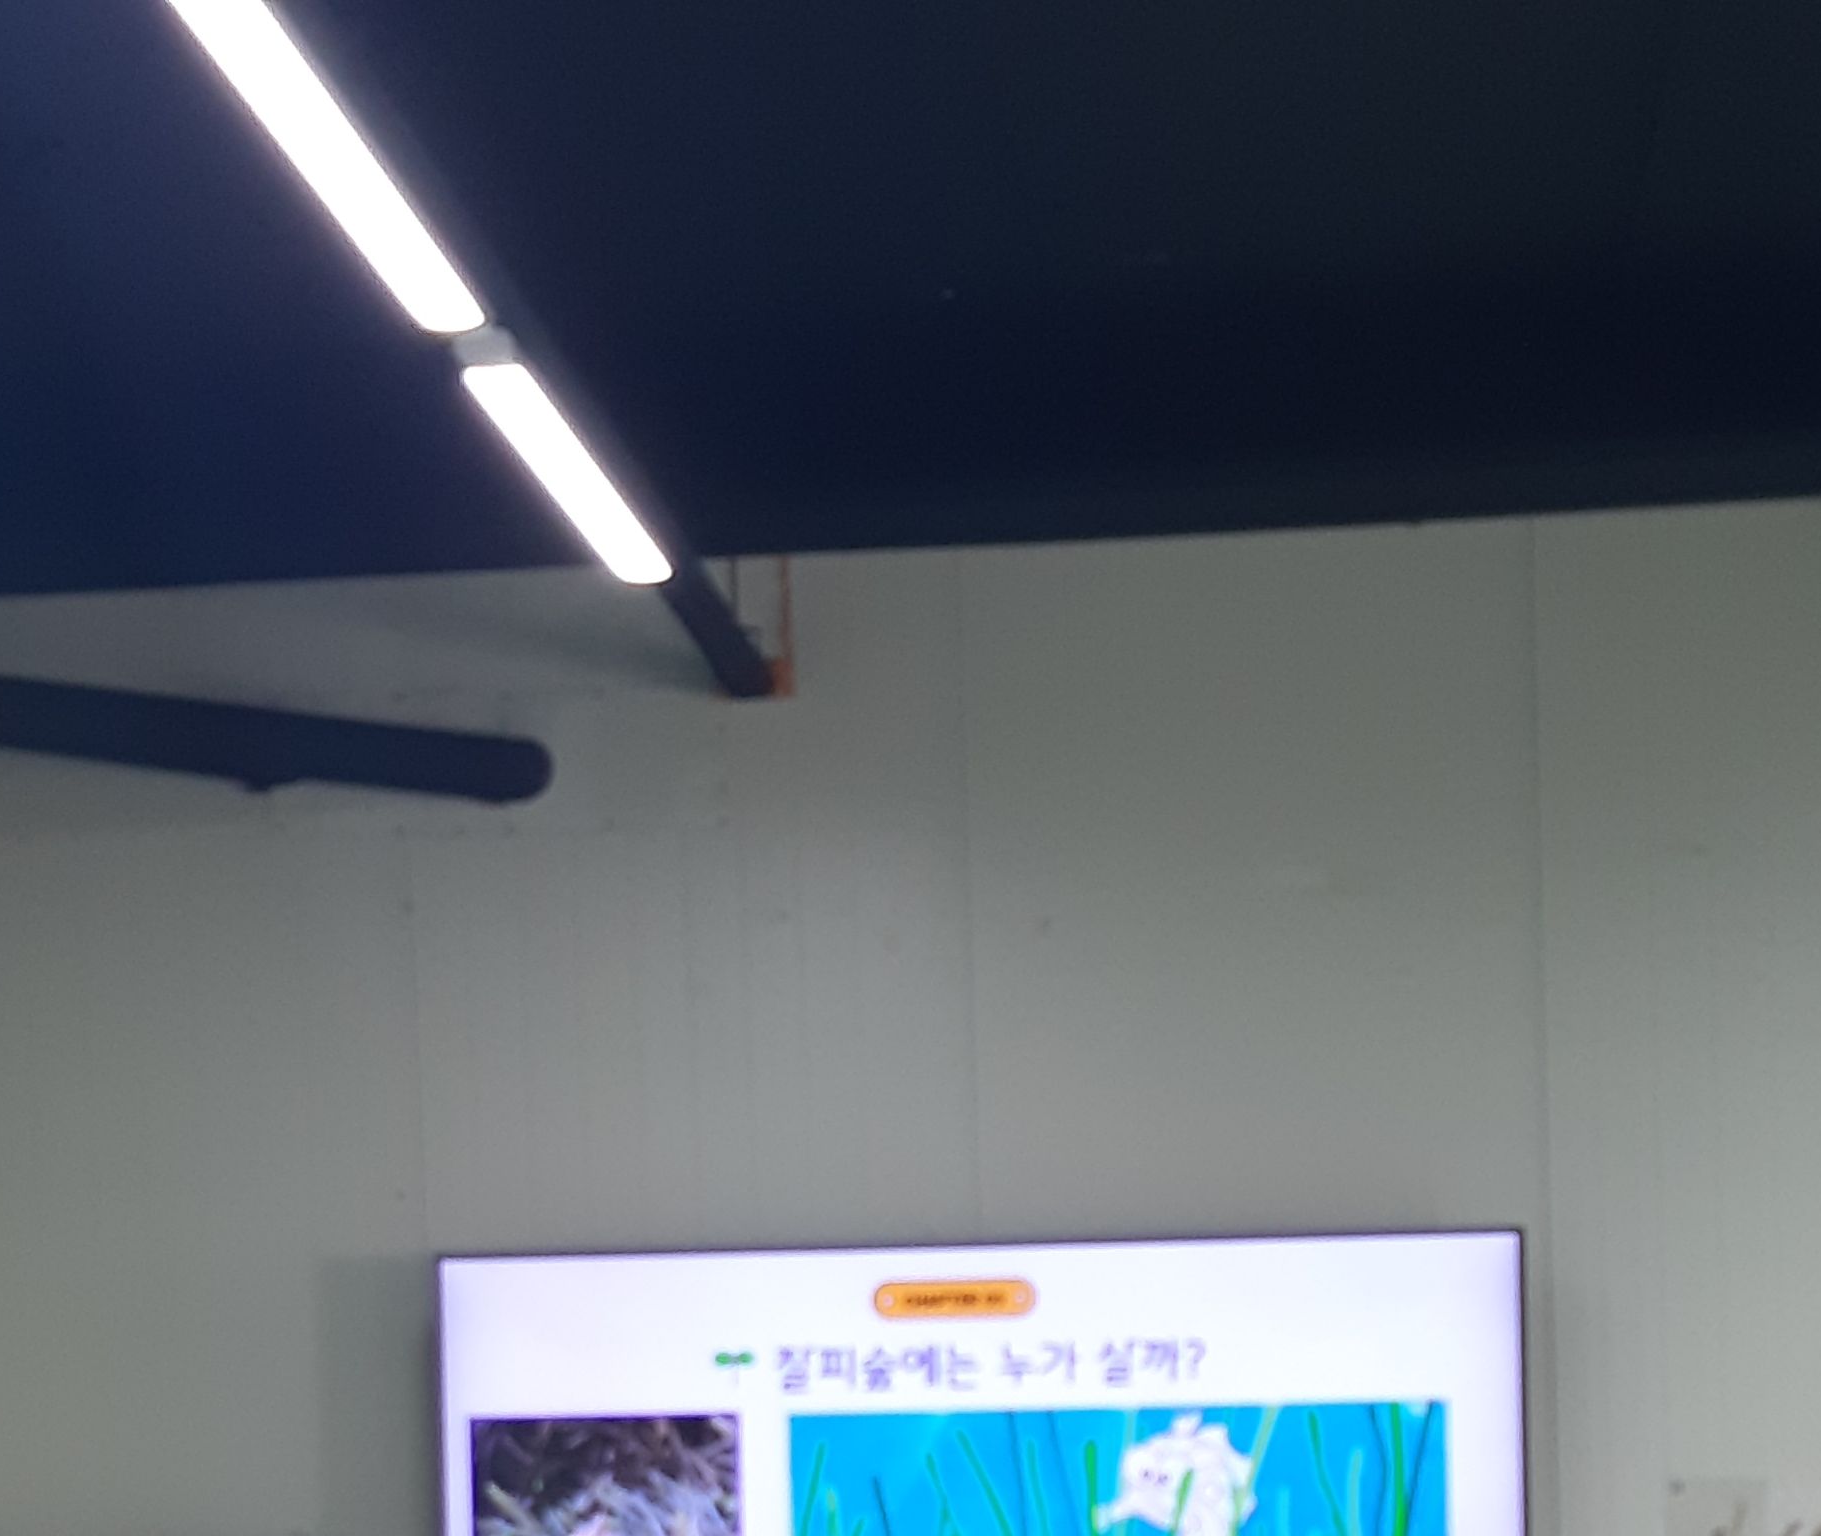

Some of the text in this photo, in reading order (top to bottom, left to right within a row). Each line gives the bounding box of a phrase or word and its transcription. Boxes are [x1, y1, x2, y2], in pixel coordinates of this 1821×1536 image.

[777, 1336, 1207, 1392] 잘피숲에는 누가 살까?
